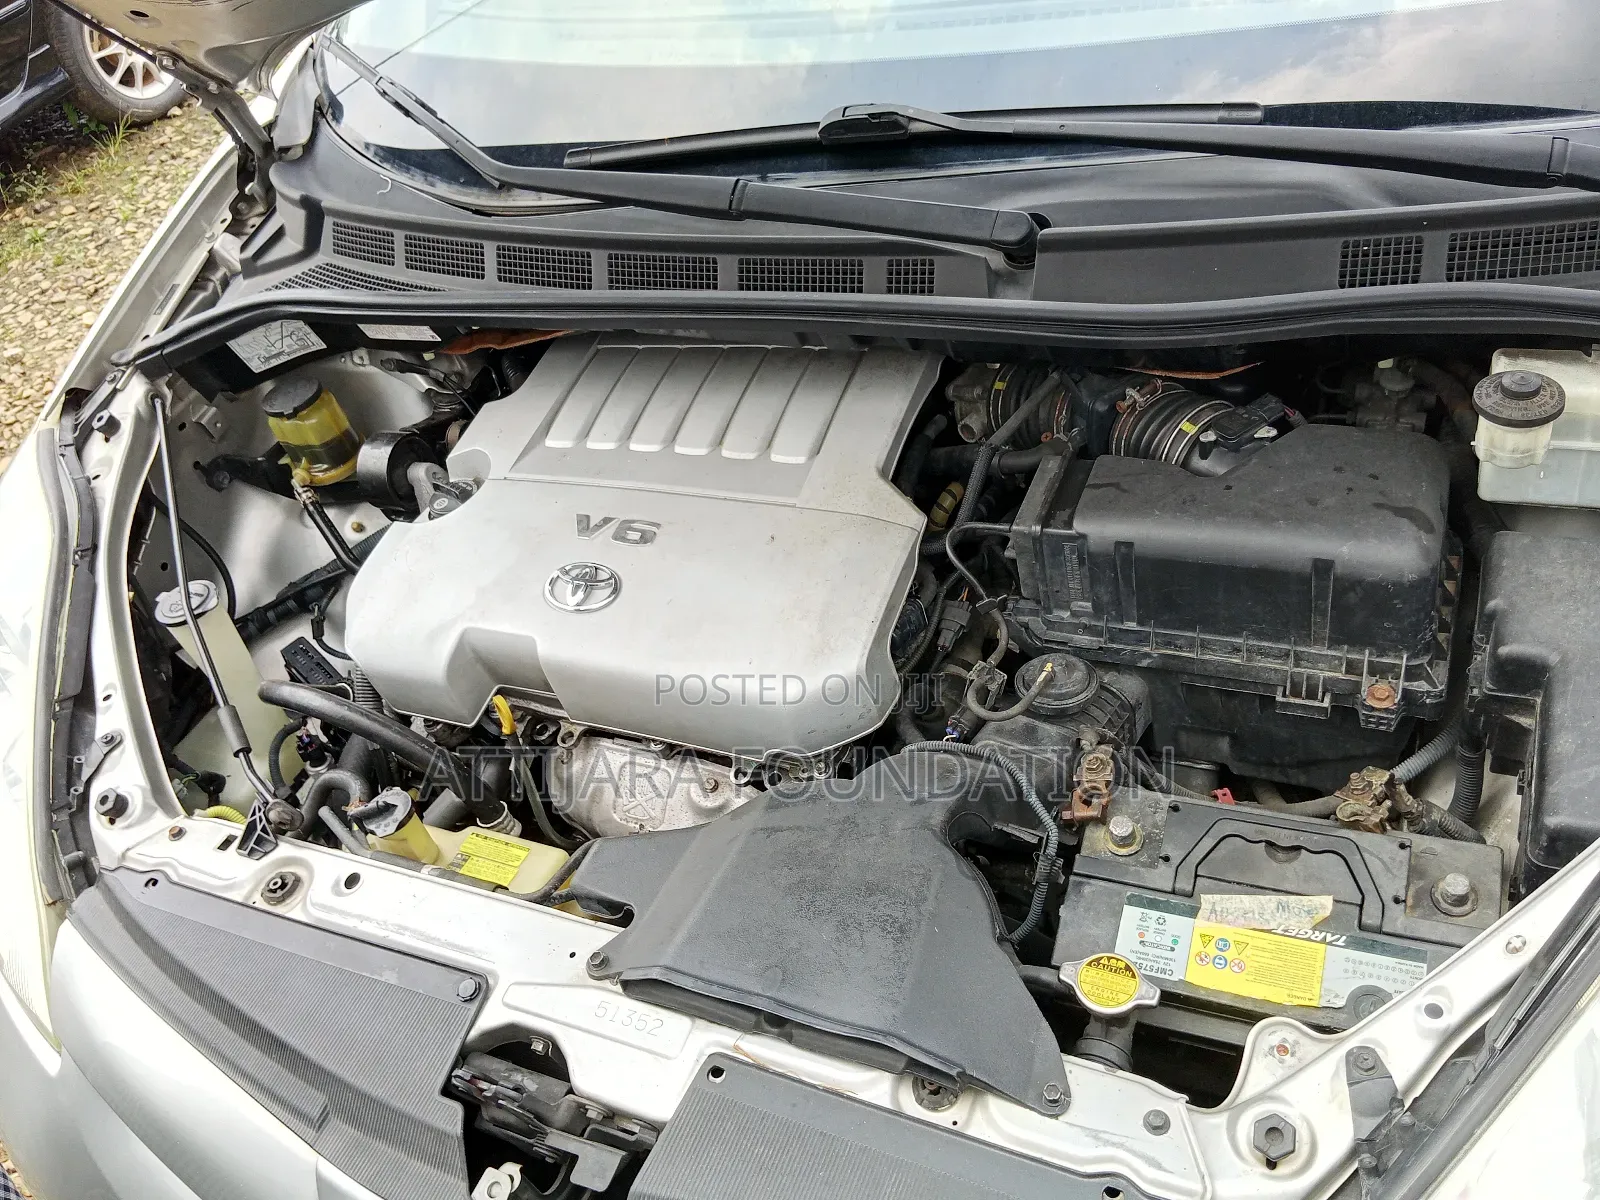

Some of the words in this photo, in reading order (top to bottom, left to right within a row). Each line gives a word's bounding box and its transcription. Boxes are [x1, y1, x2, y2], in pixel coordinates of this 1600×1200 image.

[576, 513, 662, 547] V6
[1271, 925, 1347, 946] TARGET
[1091, 961, 1133, 978] CAUTION
[594, 1000, 665, 1037] 51352
